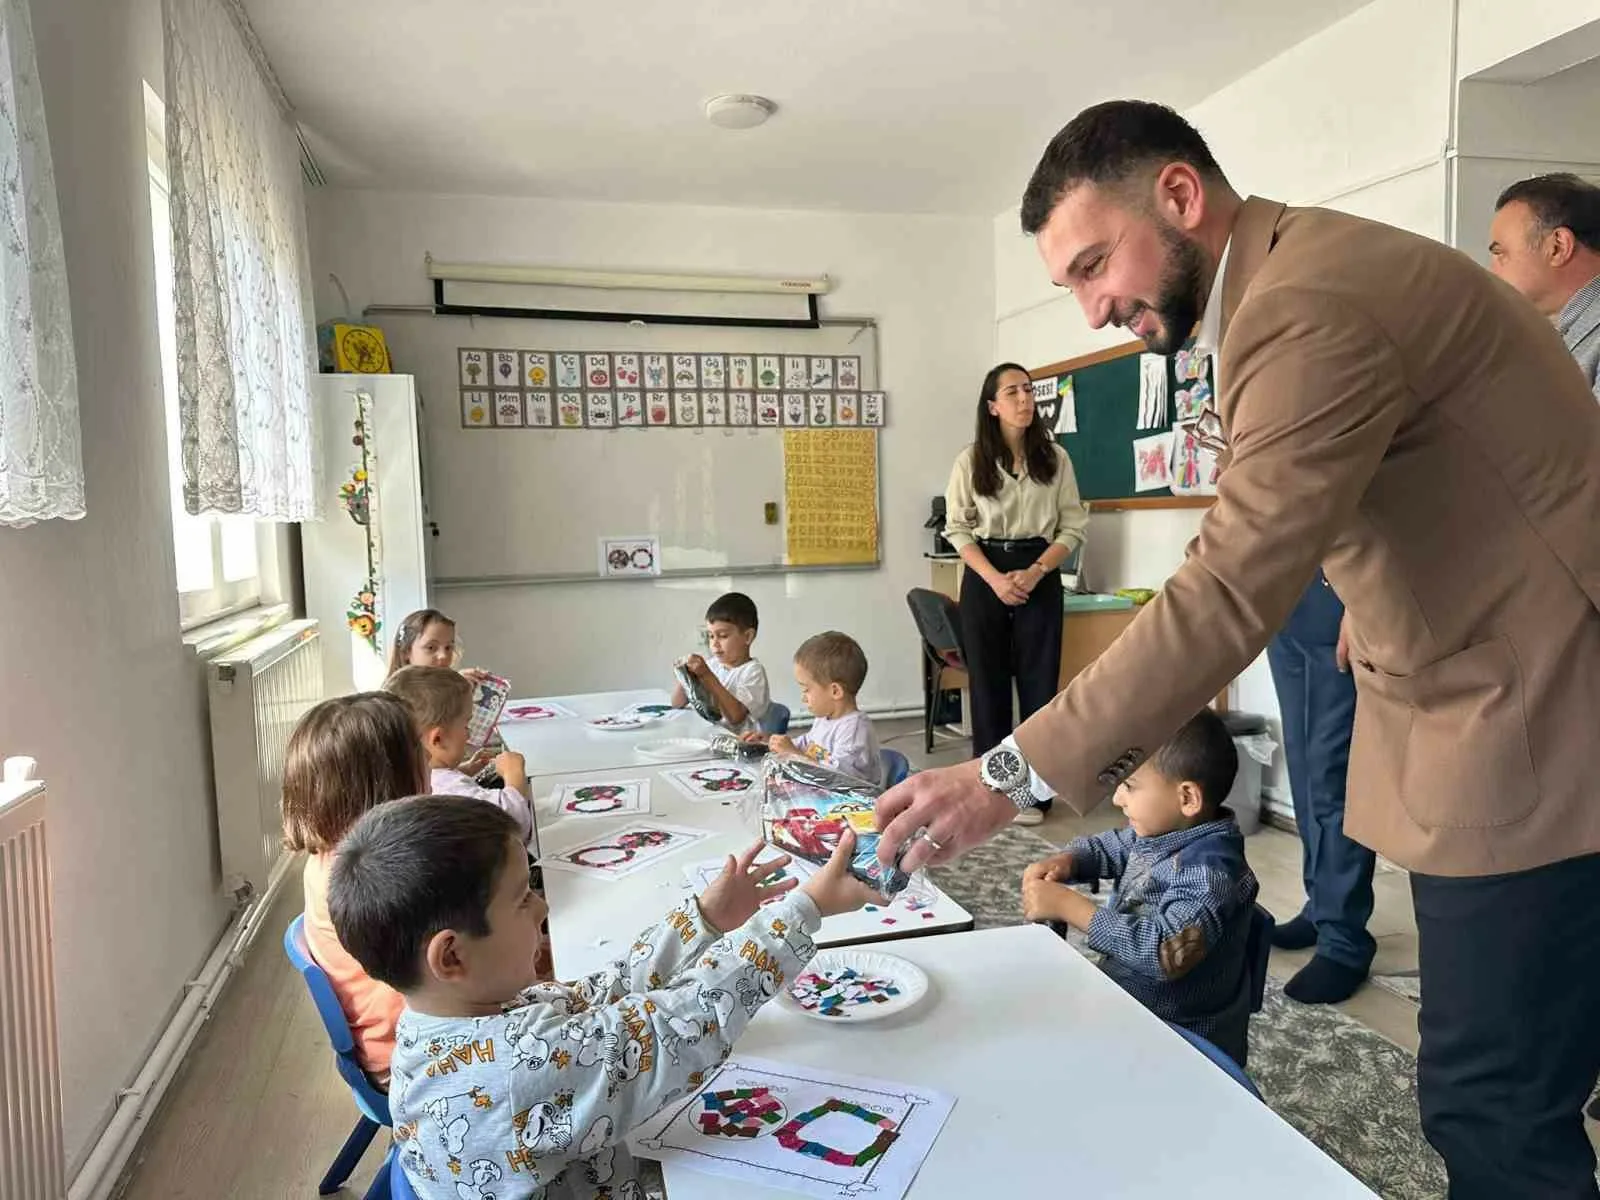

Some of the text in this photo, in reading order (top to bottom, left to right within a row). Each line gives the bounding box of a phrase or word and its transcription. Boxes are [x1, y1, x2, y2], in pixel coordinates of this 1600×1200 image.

[498, 353, 512, 362] Bb
[529, 355, 544, 365] Cc
[591, 357, 605, 366] Dd
[621, 356, 634, 365] Ee
[677, 356, 691, 367] Gg
[498, 394, 518, 402] Mm
[530, 394, 545, 402] Nn
